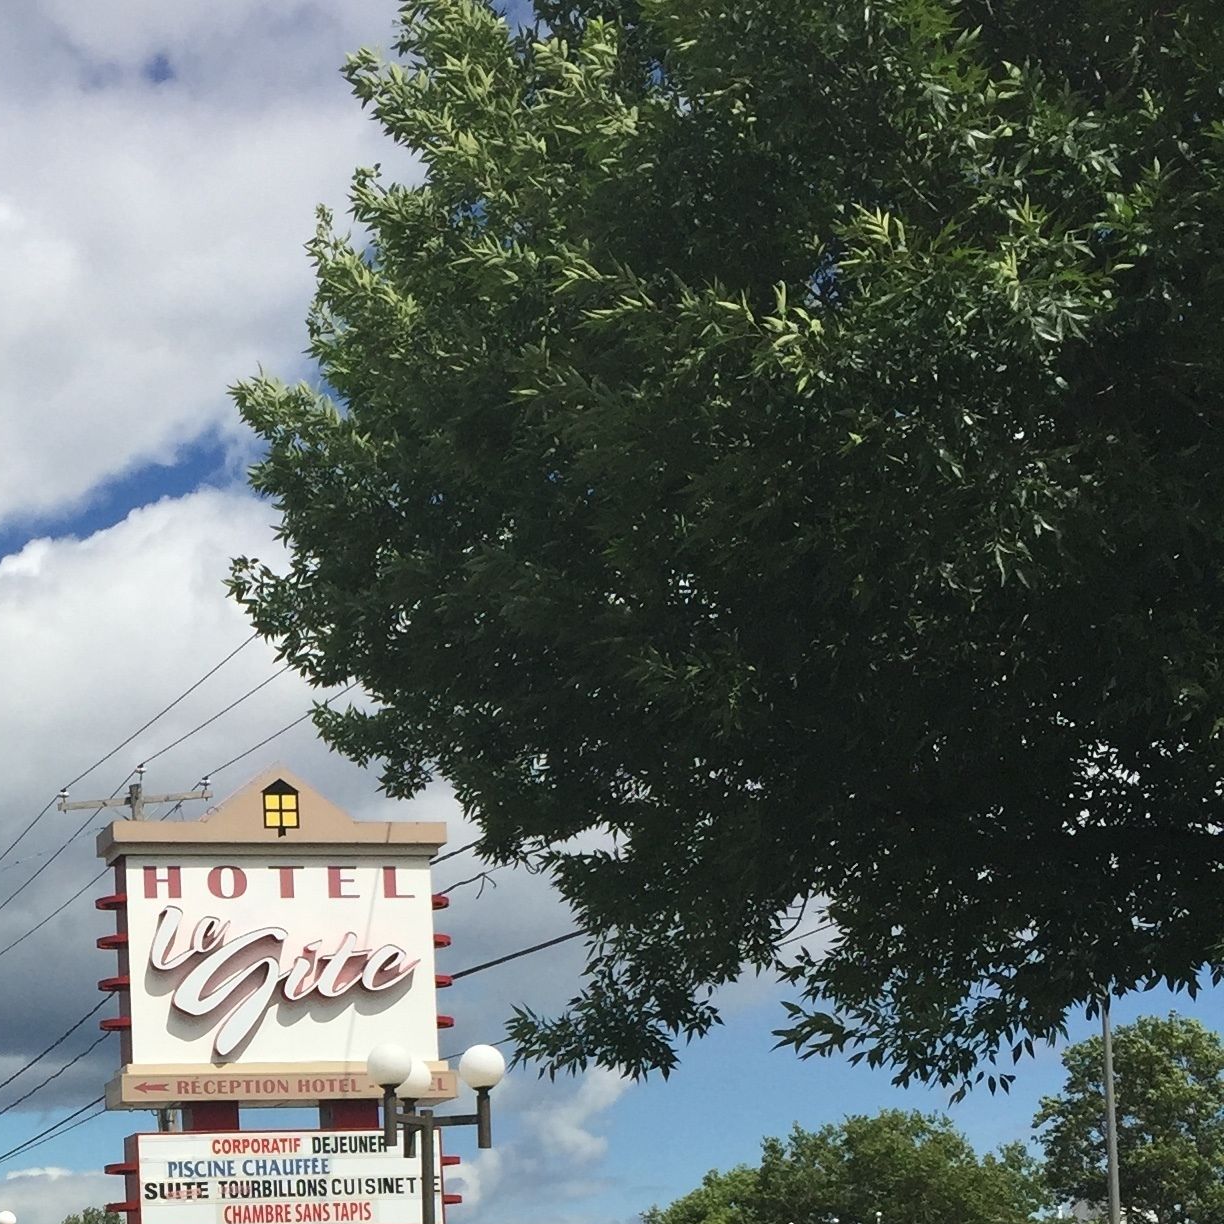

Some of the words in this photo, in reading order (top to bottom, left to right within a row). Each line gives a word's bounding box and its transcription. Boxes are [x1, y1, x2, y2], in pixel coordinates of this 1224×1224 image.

[142, 865, 416, 899] HOTEL
[150, 904, 231, 971] Le
[176, 1075, 290, 1096] RÉCEPTION
[297, 1077, 362, 1094] HOTEL
[211, 1137, 301, 1155] CORPORATIF
[311, 1135, 388, 1154] DEJEUNER
[167, 1160, 236, 1178] PISCINE
[144, 1181, 209, 1200] SUITE
[217, 1178, 327, 1199] TOURBILLONS
[331, 1176, 441, 1196] CUISINETE
[223, 1203, 291, 1224] CHAMBRE
[294, 1203, 331, 1223] SANS
[332, 1201, 372, 1222] TAPIS
